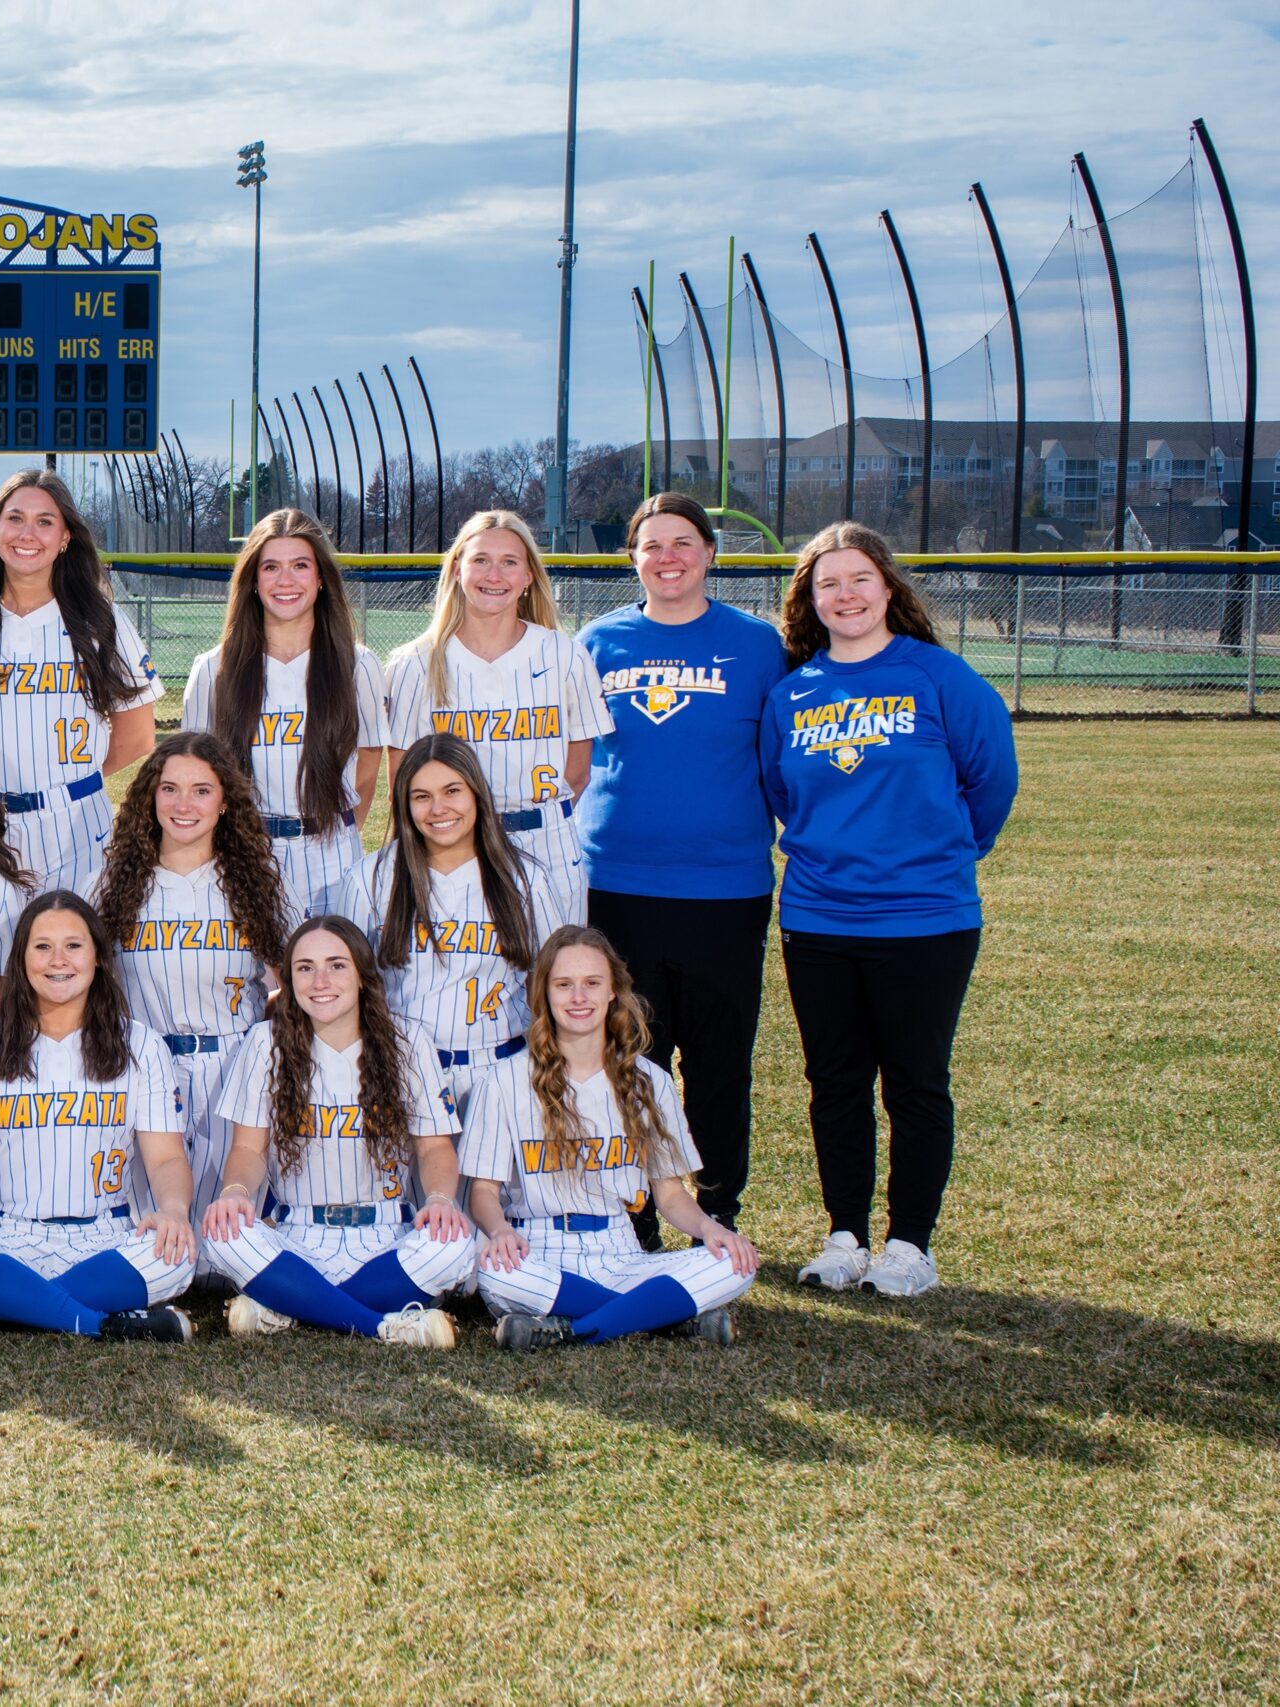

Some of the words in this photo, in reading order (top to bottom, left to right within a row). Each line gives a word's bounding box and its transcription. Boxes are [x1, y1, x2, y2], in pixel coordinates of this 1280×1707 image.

[74, 291, 116, 319] H/E
[59, 338, 100, 359] HITS
[118, 339, 154, 359] ERR
[602, 667, 727, 692] SOFTBALL
[431, 705, 560, 742] WAYZATA
[789, 711, 915, 749] TROJANS
[793, 696, 916, 730] WAYZATA
[54, 717, 92, 765] 12
[531, 764, 558, 803] 6
[224, 976, 245, 1016] 7
[465, 977, 506, 1025] 14
[91, 1148, 127, 1198] 13
